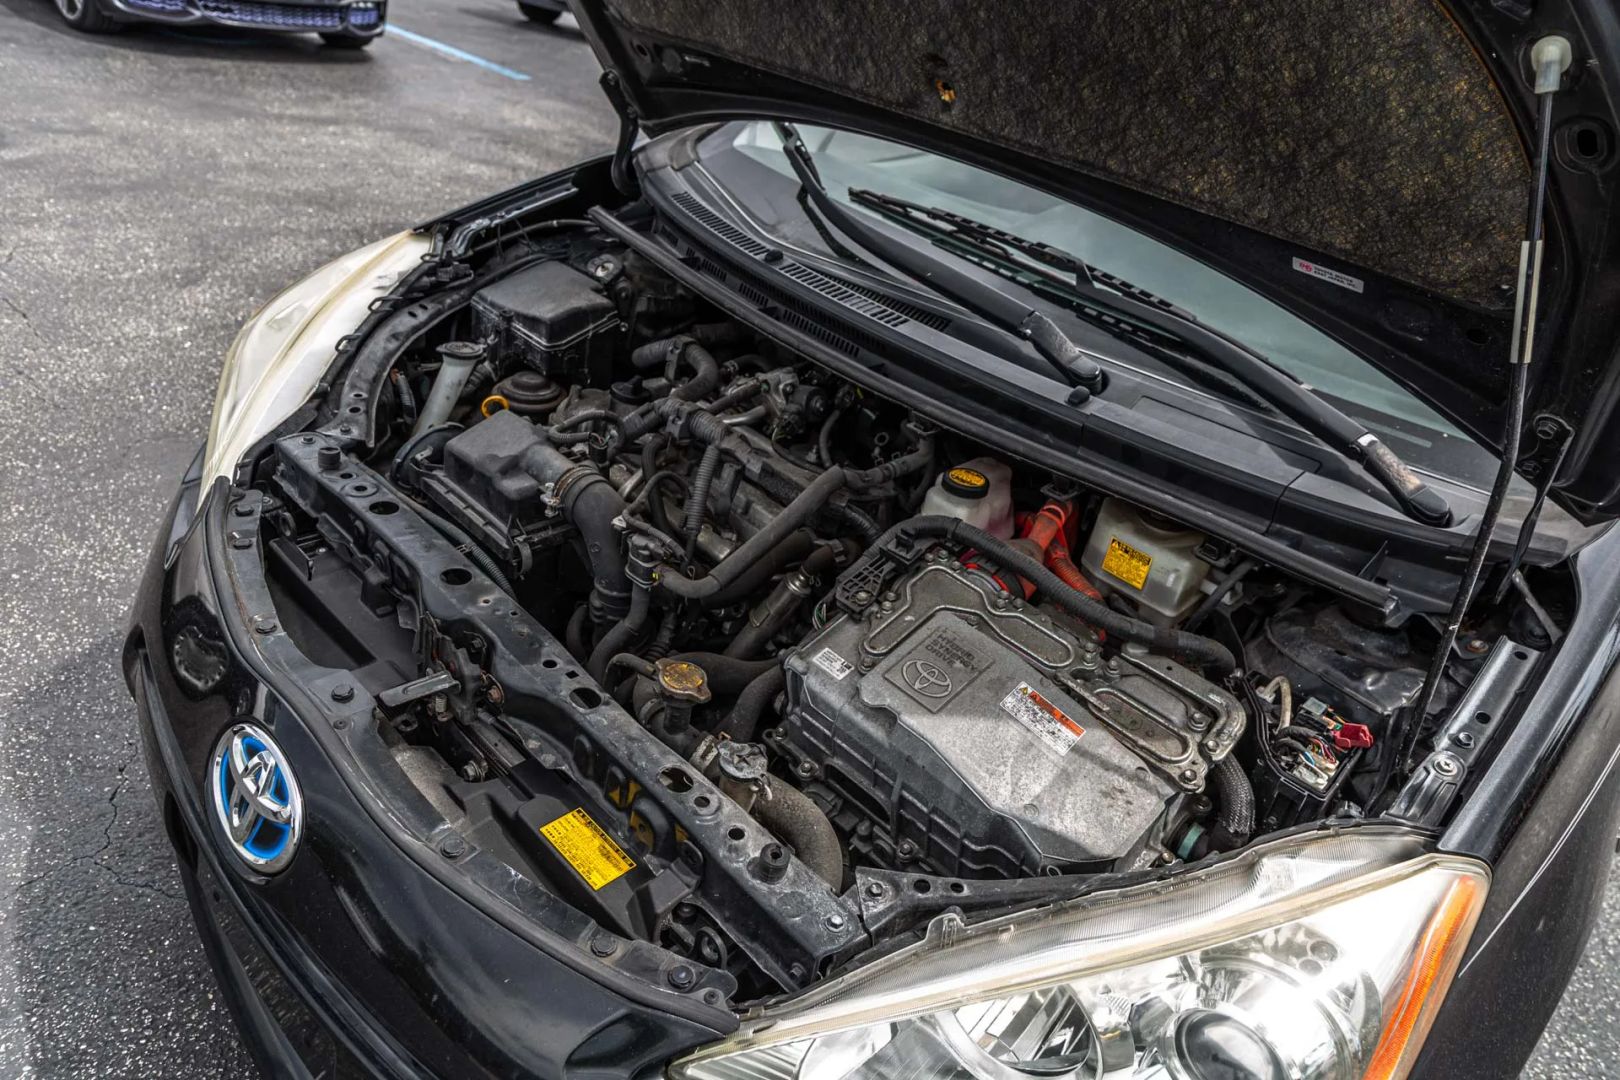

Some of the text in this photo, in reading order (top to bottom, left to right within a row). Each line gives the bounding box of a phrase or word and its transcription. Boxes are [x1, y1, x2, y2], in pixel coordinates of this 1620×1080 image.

[925, 644, 956, 668] DRIVE
[931, 639, 977, 670] SYNERGY
[937, 634, 975, 661] HYBRID
